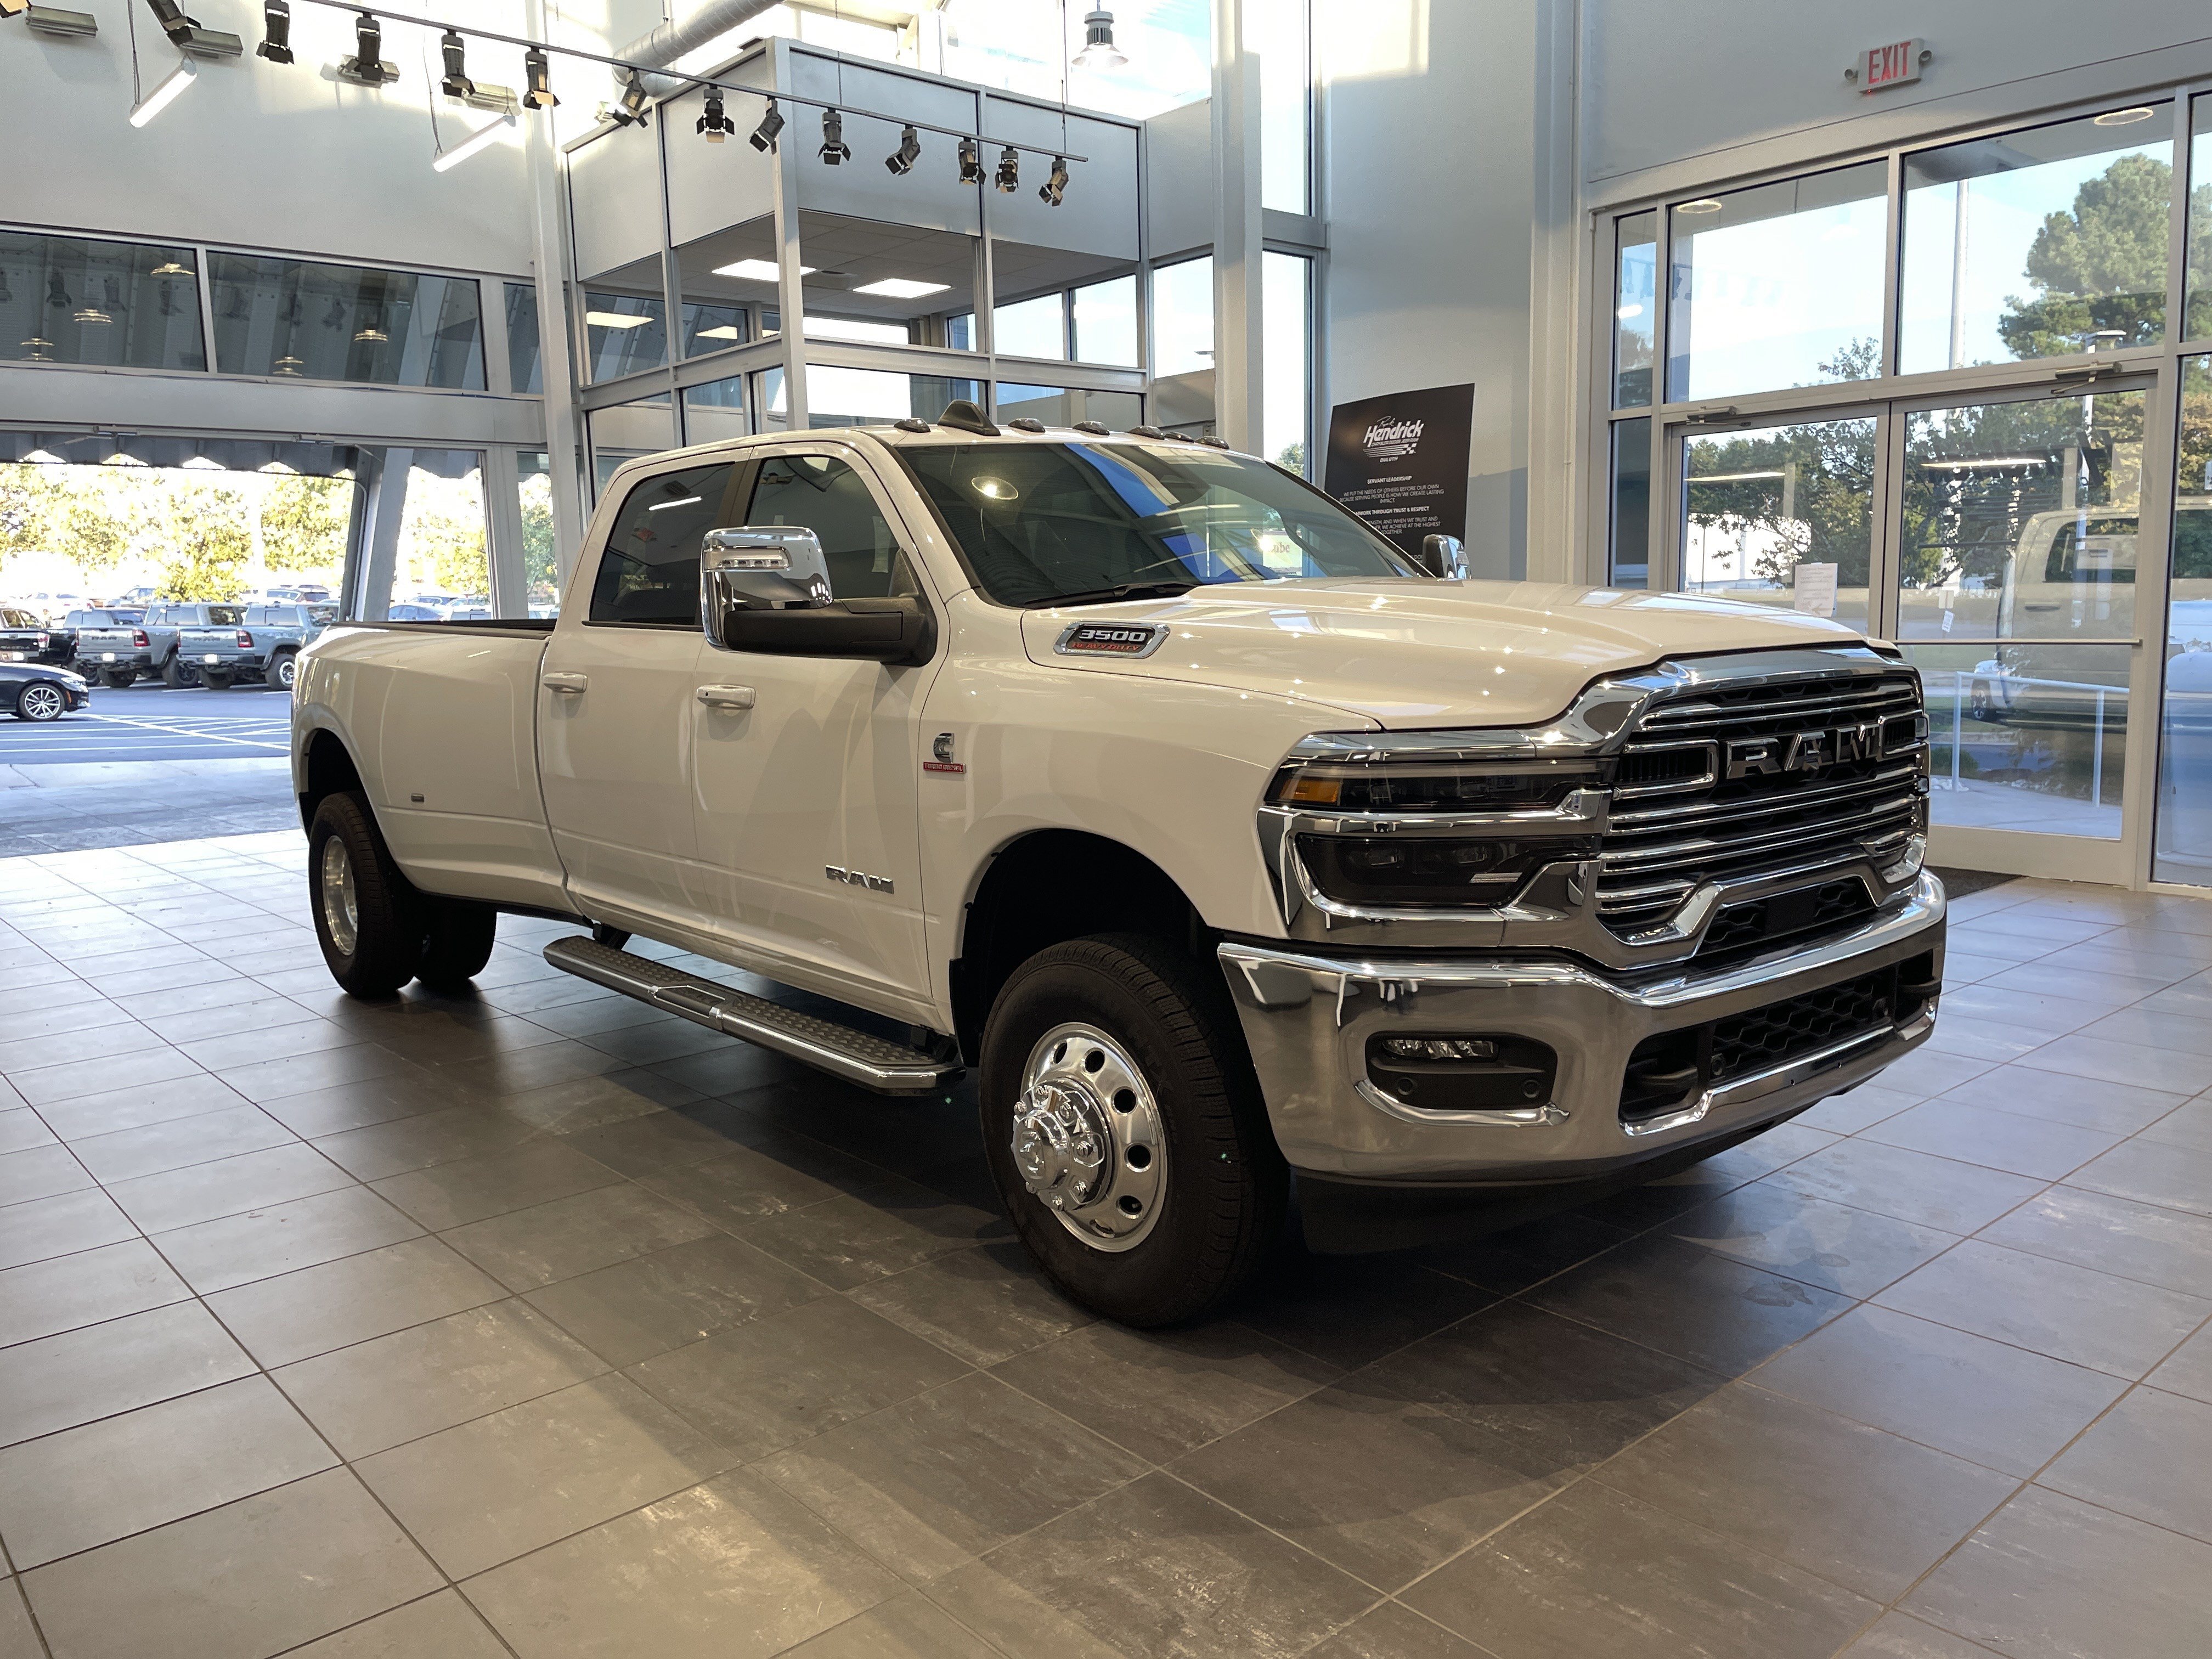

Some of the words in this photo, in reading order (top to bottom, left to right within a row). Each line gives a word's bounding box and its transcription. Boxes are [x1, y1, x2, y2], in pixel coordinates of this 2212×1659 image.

[1869, 41, 1911, 84] EXIT
[1363, 420, 1424, 448] Hendrick
[1079, 629, 1147, 642] 3500
[1726, 724, 1880, 780] RAM
[826, 864, 895, 895] RAM
